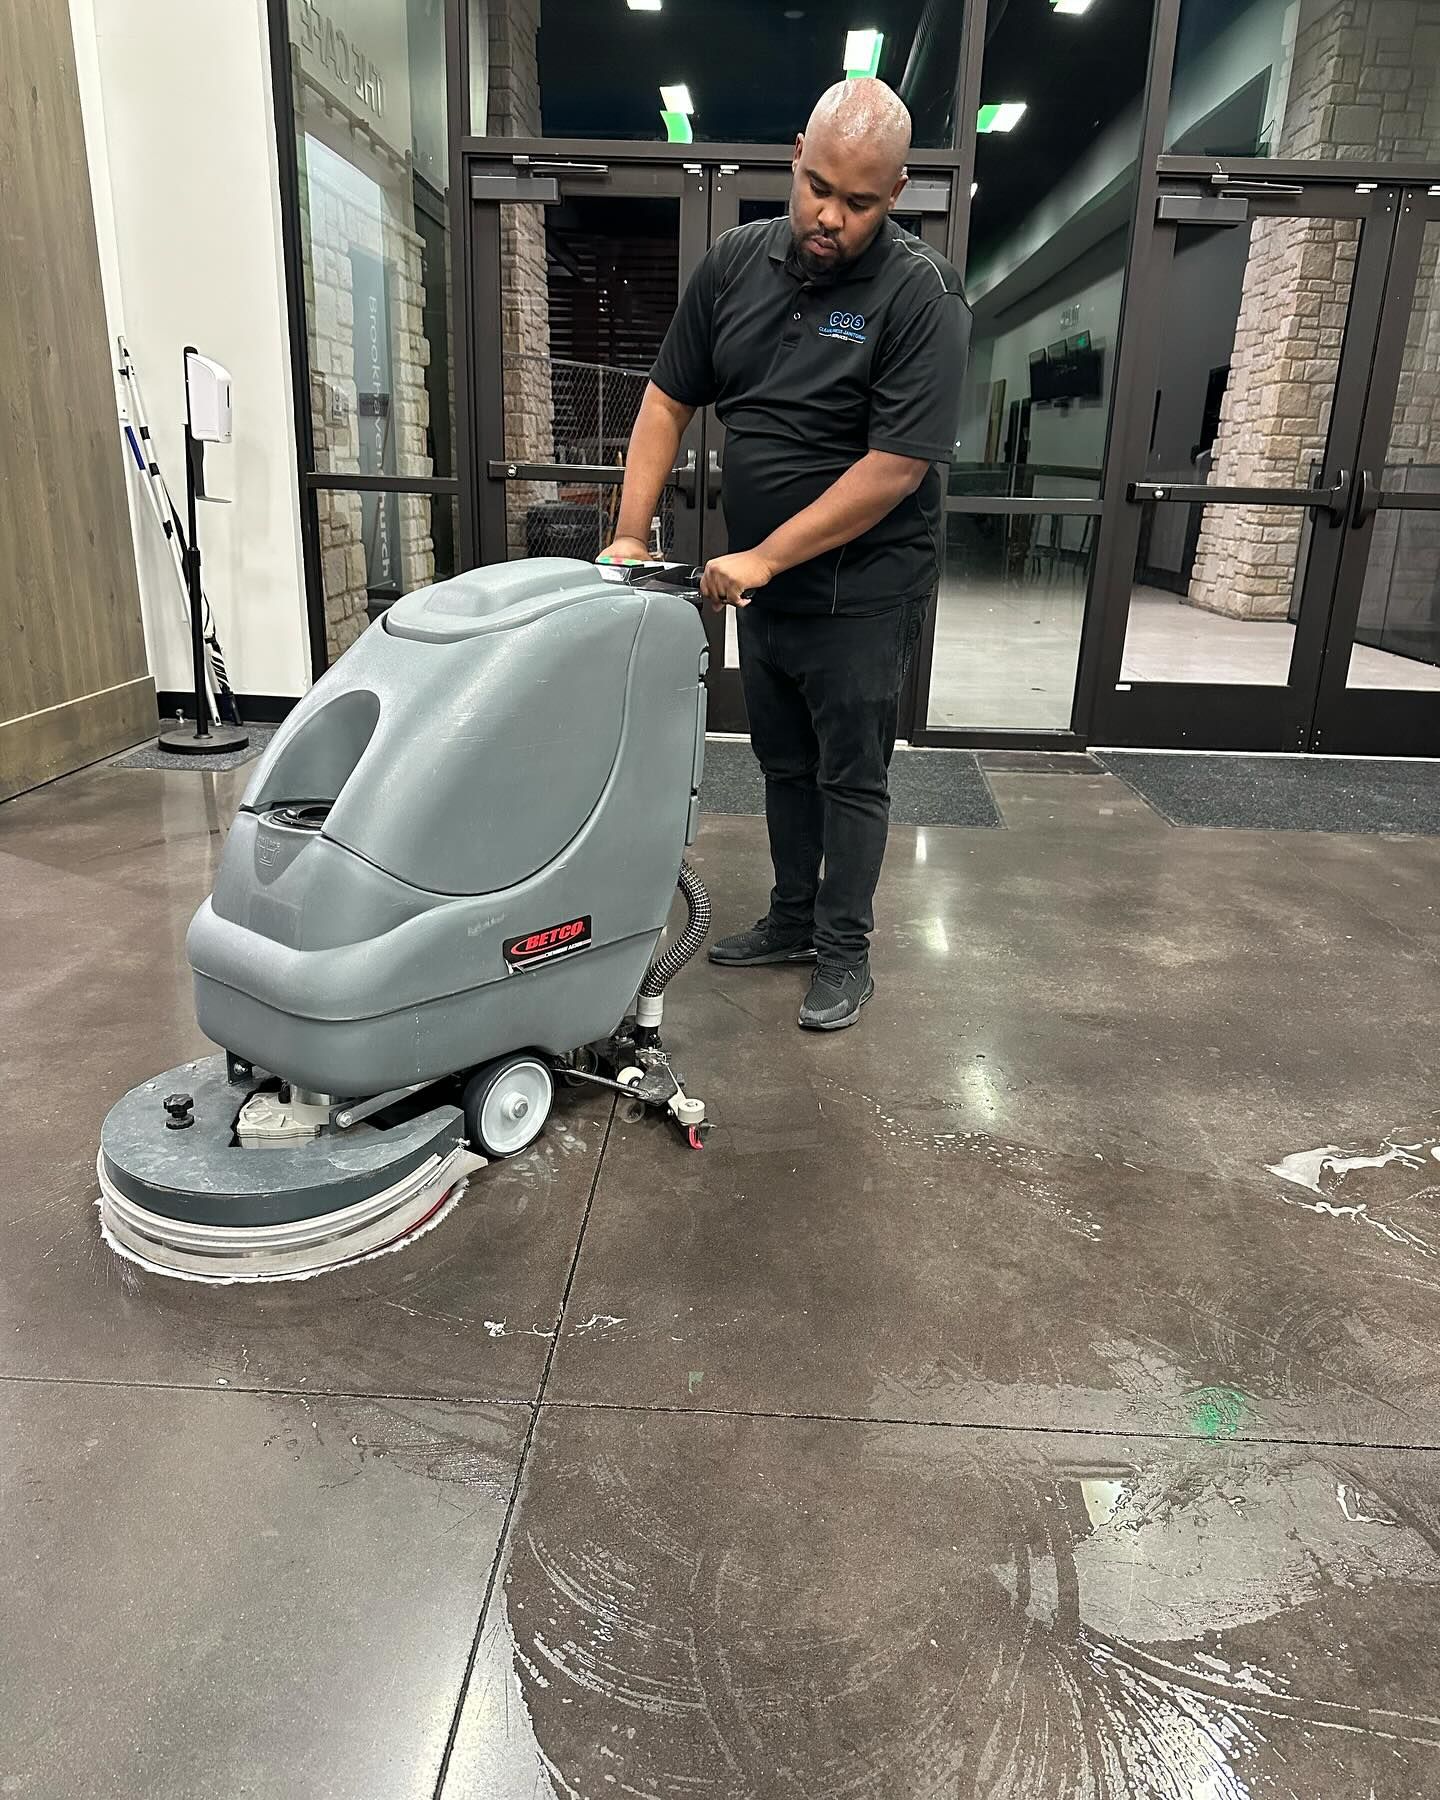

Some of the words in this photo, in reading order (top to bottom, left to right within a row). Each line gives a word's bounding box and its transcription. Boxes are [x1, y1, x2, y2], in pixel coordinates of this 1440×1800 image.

[831, 313, 863, 328] CJS
[367, 295, 384, 468] Brookhaven
[525, 921, 584, 951] BETCO
